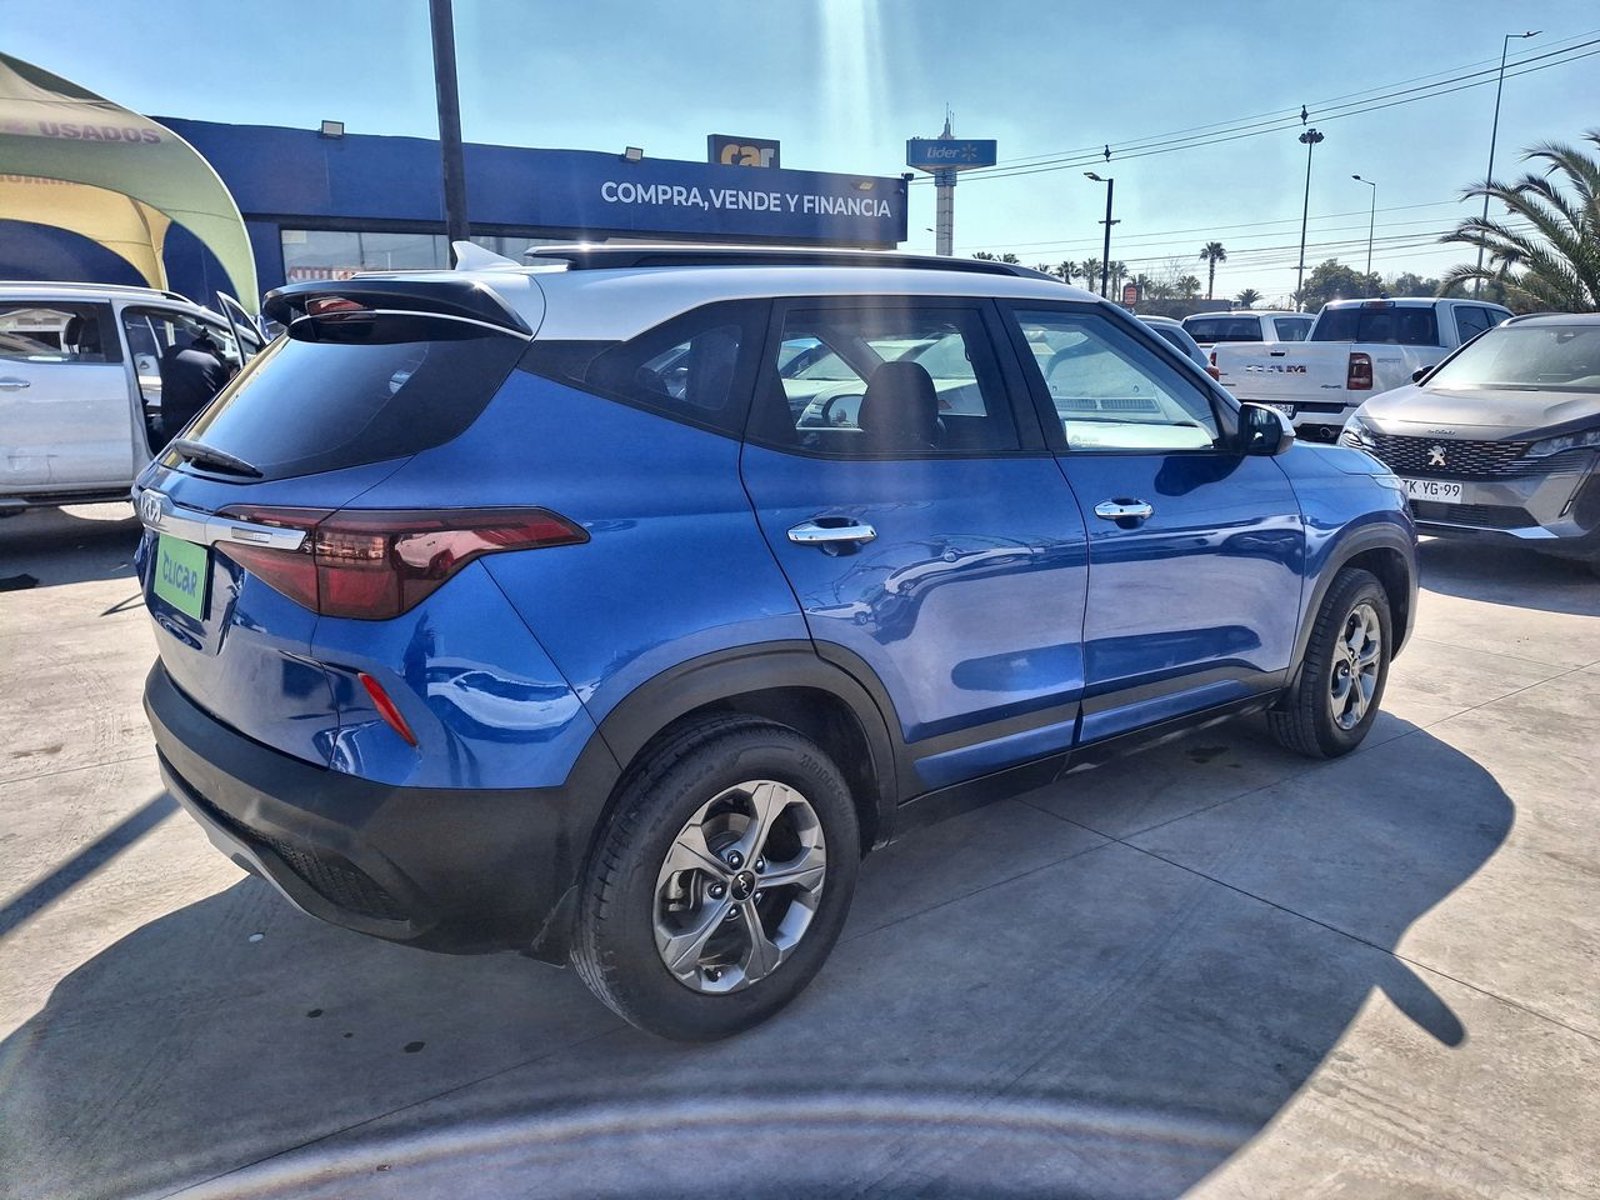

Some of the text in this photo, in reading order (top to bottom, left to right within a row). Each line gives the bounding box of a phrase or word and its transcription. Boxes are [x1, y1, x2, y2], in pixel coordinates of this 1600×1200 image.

[38, 121, 161, 144] USADOS
[785, 193, 799, 213] Y
[803, 194, 892, 218] FINANCIA
